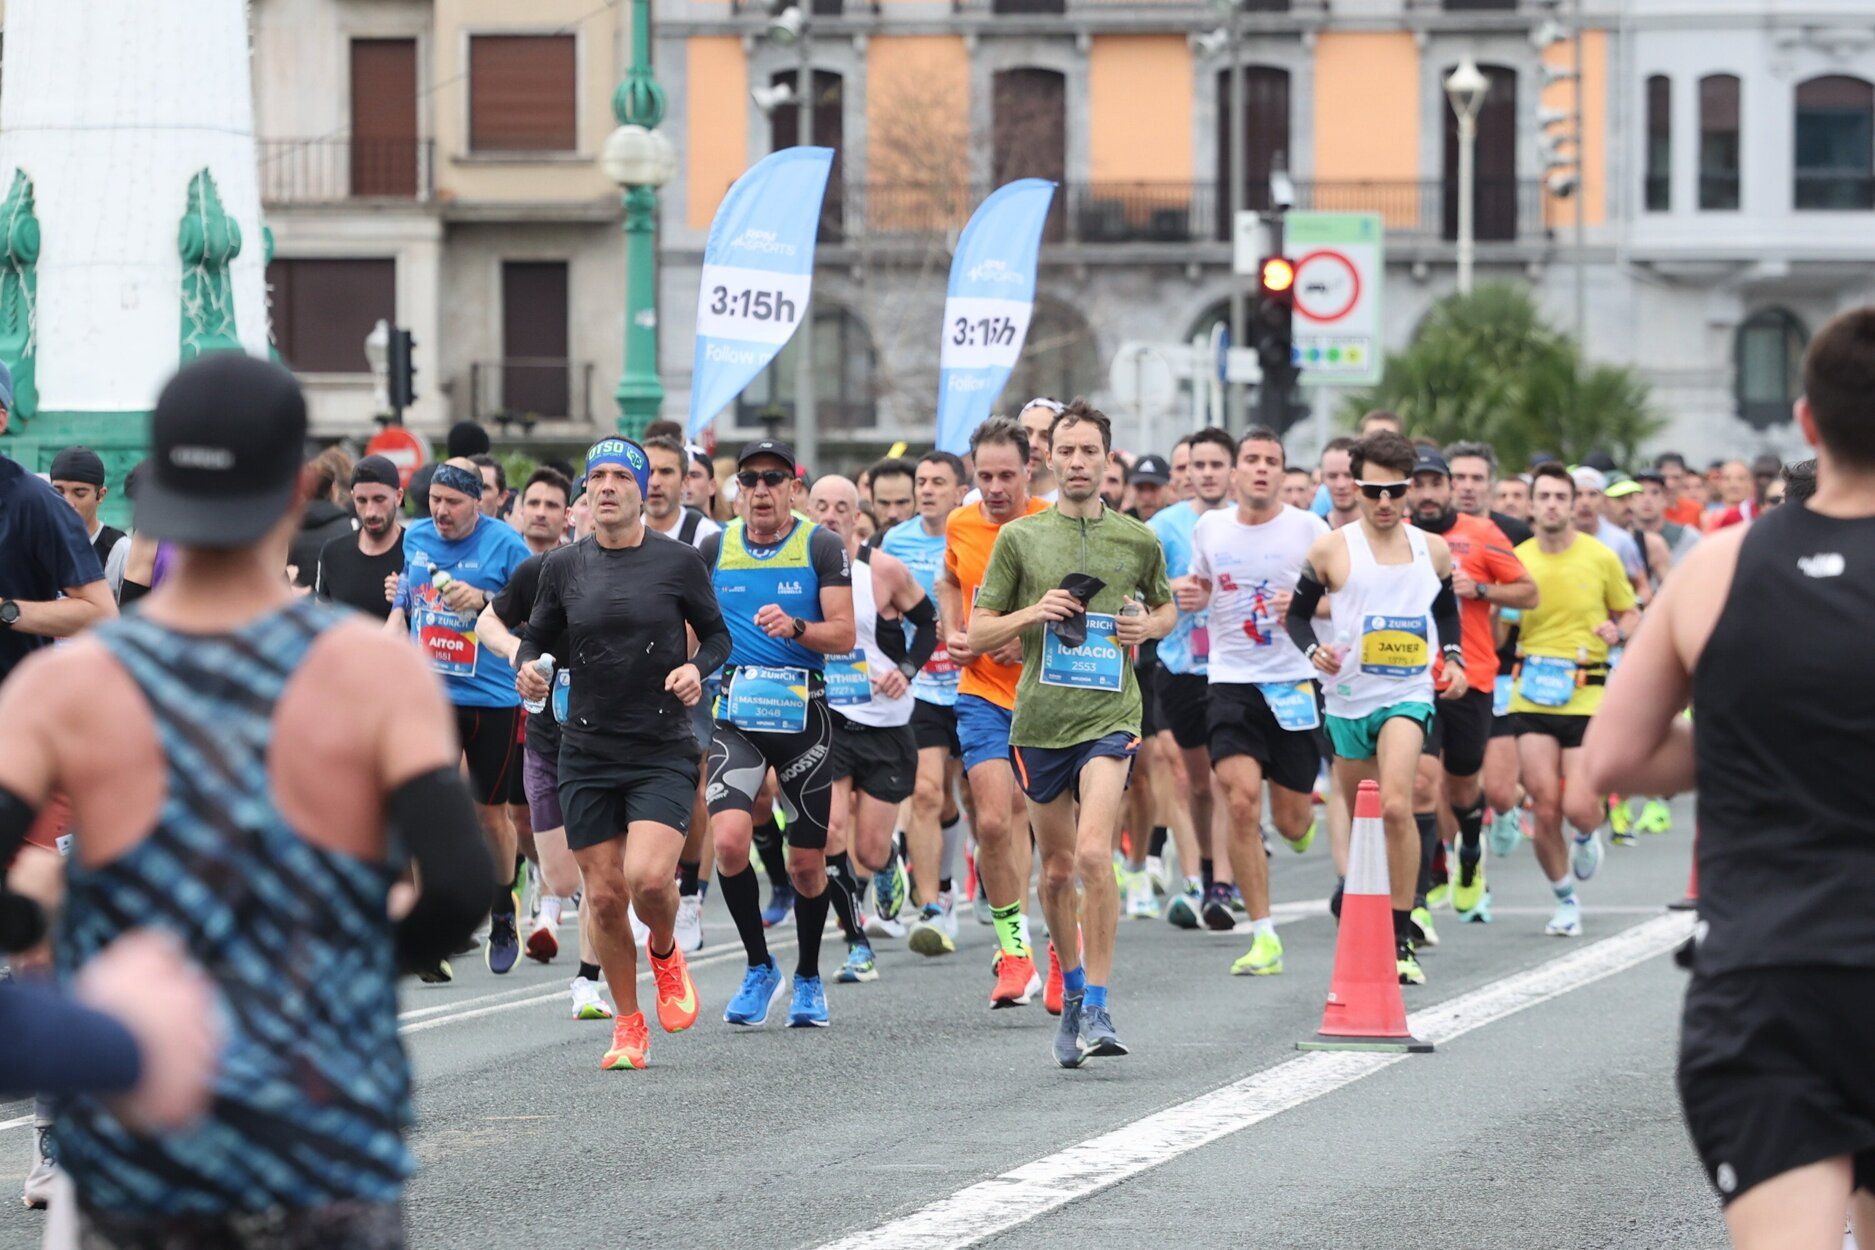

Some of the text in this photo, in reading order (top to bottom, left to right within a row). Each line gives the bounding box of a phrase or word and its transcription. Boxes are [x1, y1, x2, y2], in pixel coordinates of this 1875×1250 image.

[711, 285, 796, 323] 3:15h
[706, 343, 754, 364] Follow
[1086, 620, 1113, 631] URICH
[429, 637, 464, 652] AITOR
[1378, 643, 1419, 653] JAVIER
[1057, 643, 1118, 660] IGNACIO
[1071, 661, 1097, 672] 2553
[760, 671, 796, 682] ZURICH
[824, 673, 866, 684] ATTHIEU
[738, 696, 804, 708] MASSIMILIANO
[755, 706, 782, 717] 3048
[780, 744, 829, 783] BOOSTER
